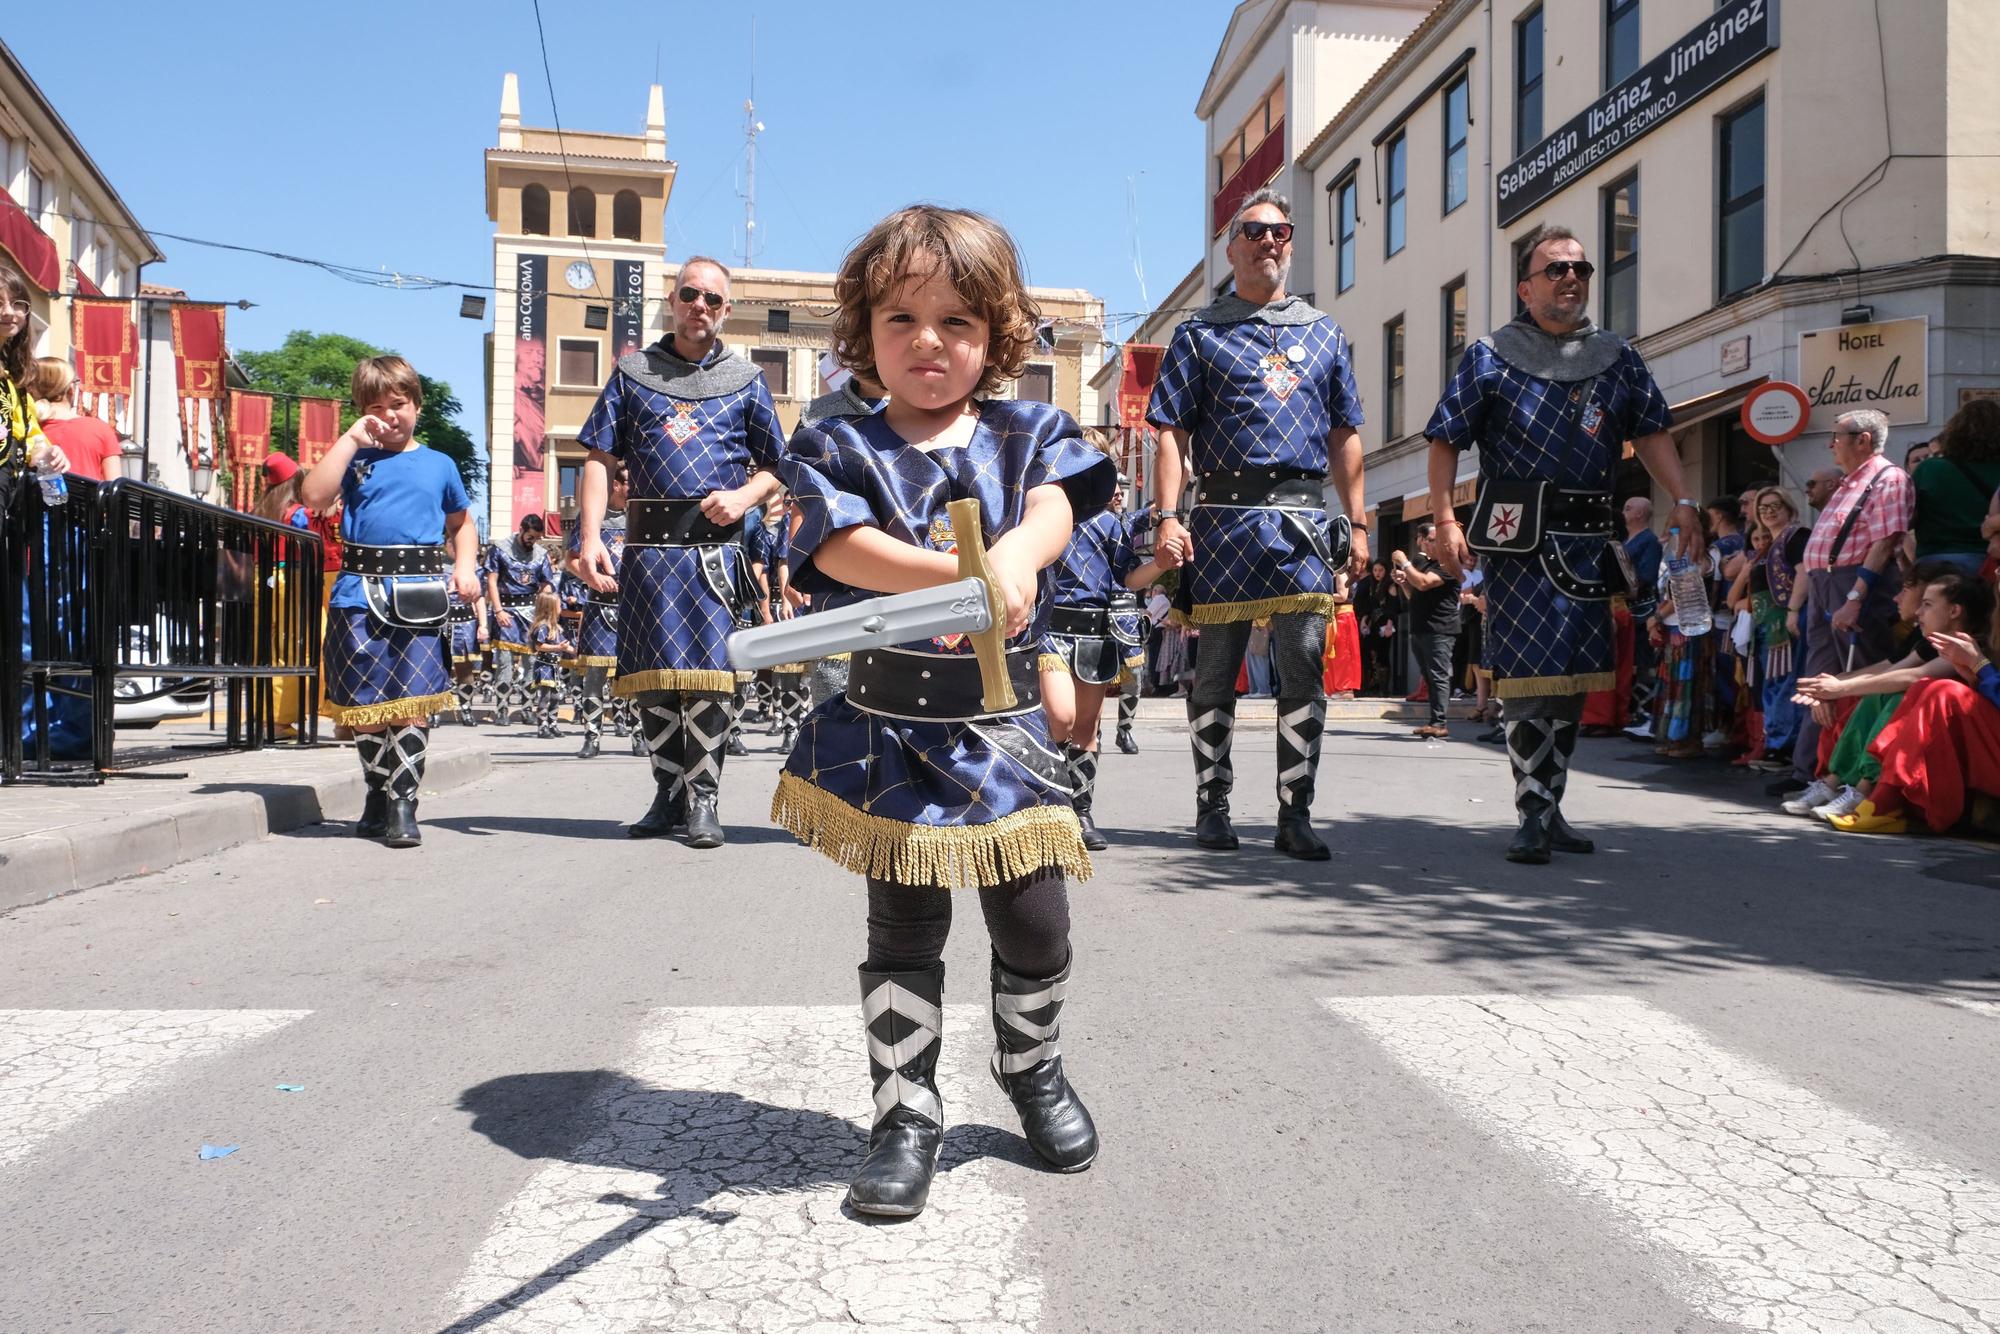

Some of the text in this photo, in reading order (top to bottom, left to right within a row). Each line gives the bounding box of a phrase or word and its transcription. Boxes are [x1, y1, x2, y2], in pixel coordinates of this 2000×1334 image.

[1499, 0, 1764, 200] Sebastián Ibáñez Jiménez
[1552, 90, 1677, 186] ARQUITECTO TÉCNICO
[520, 315, 532, 341] año
[1808, 355, 1920, 408] Santa Ana
